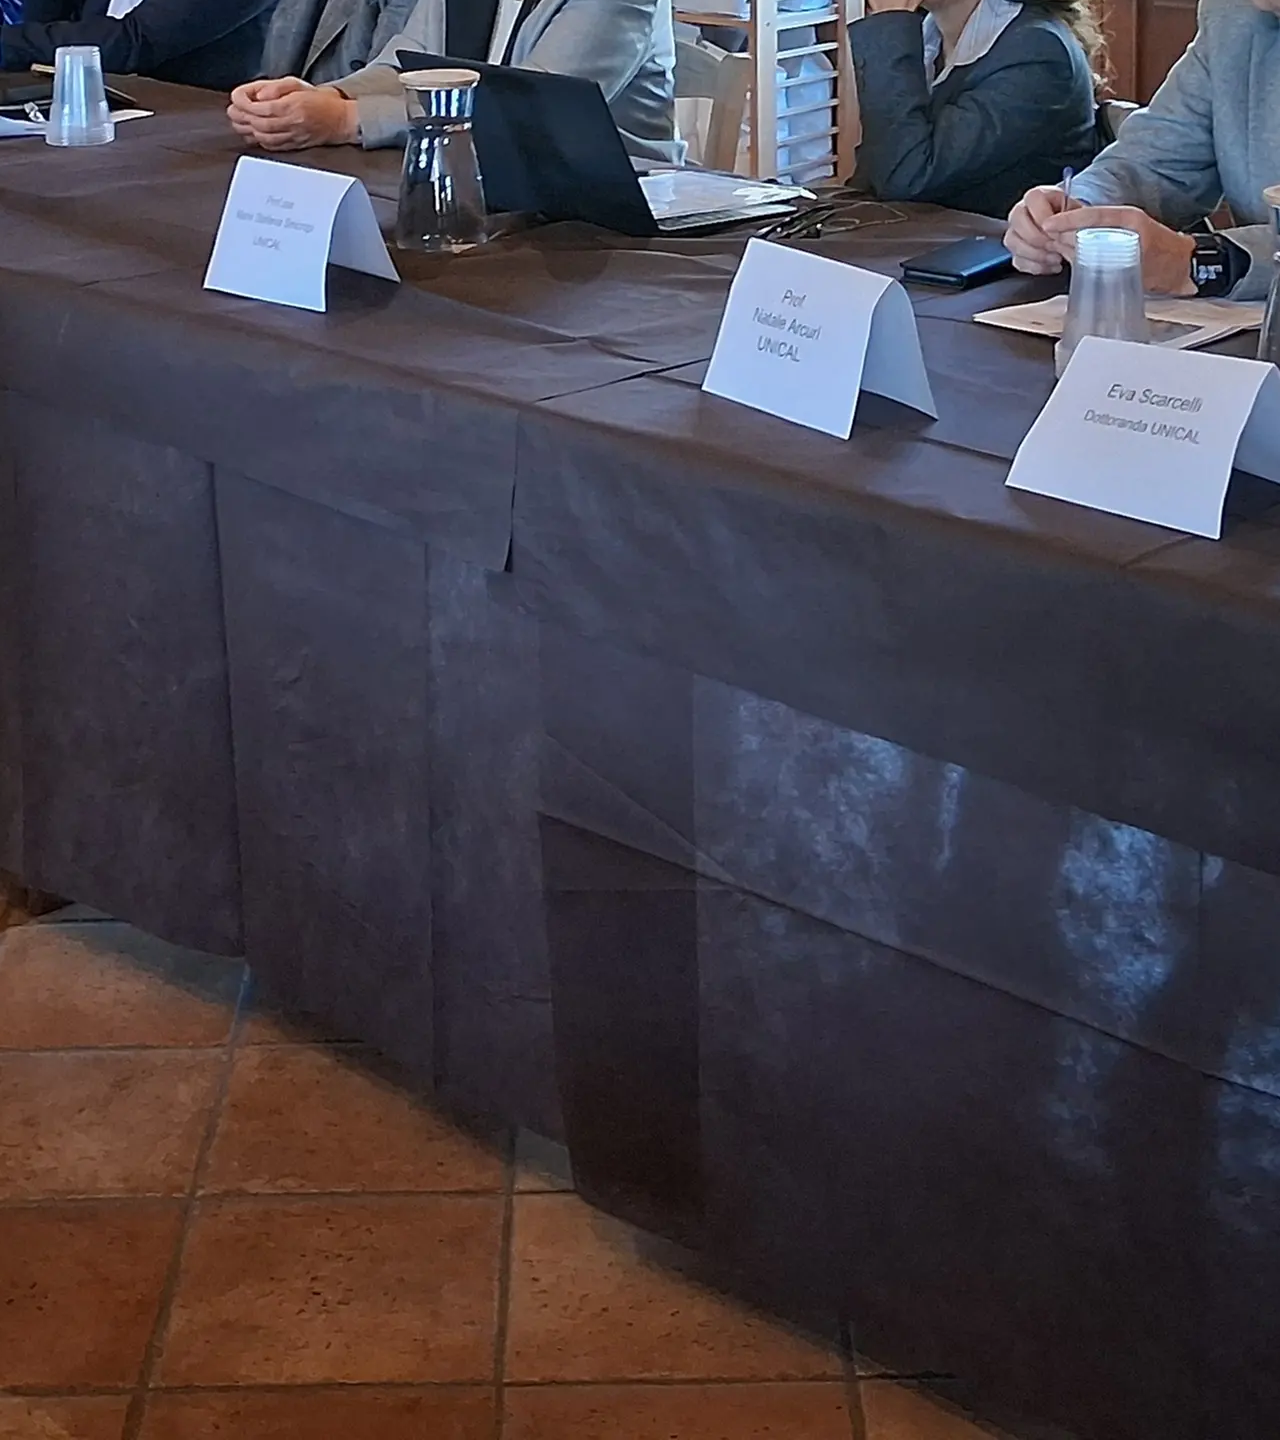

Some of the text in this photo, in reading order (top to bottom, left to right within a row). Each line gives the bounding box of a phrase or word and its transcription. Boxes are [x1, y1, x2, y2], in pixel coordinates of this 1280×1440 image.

[752, 307, 822, 341] Natale Arcuri
[756, 335, 802, 363] UNICAL
[1107, 383, 1204, 413] Eva Scarcelli
[1084, 409, 1201, 445] Dottoranda UNICAL
